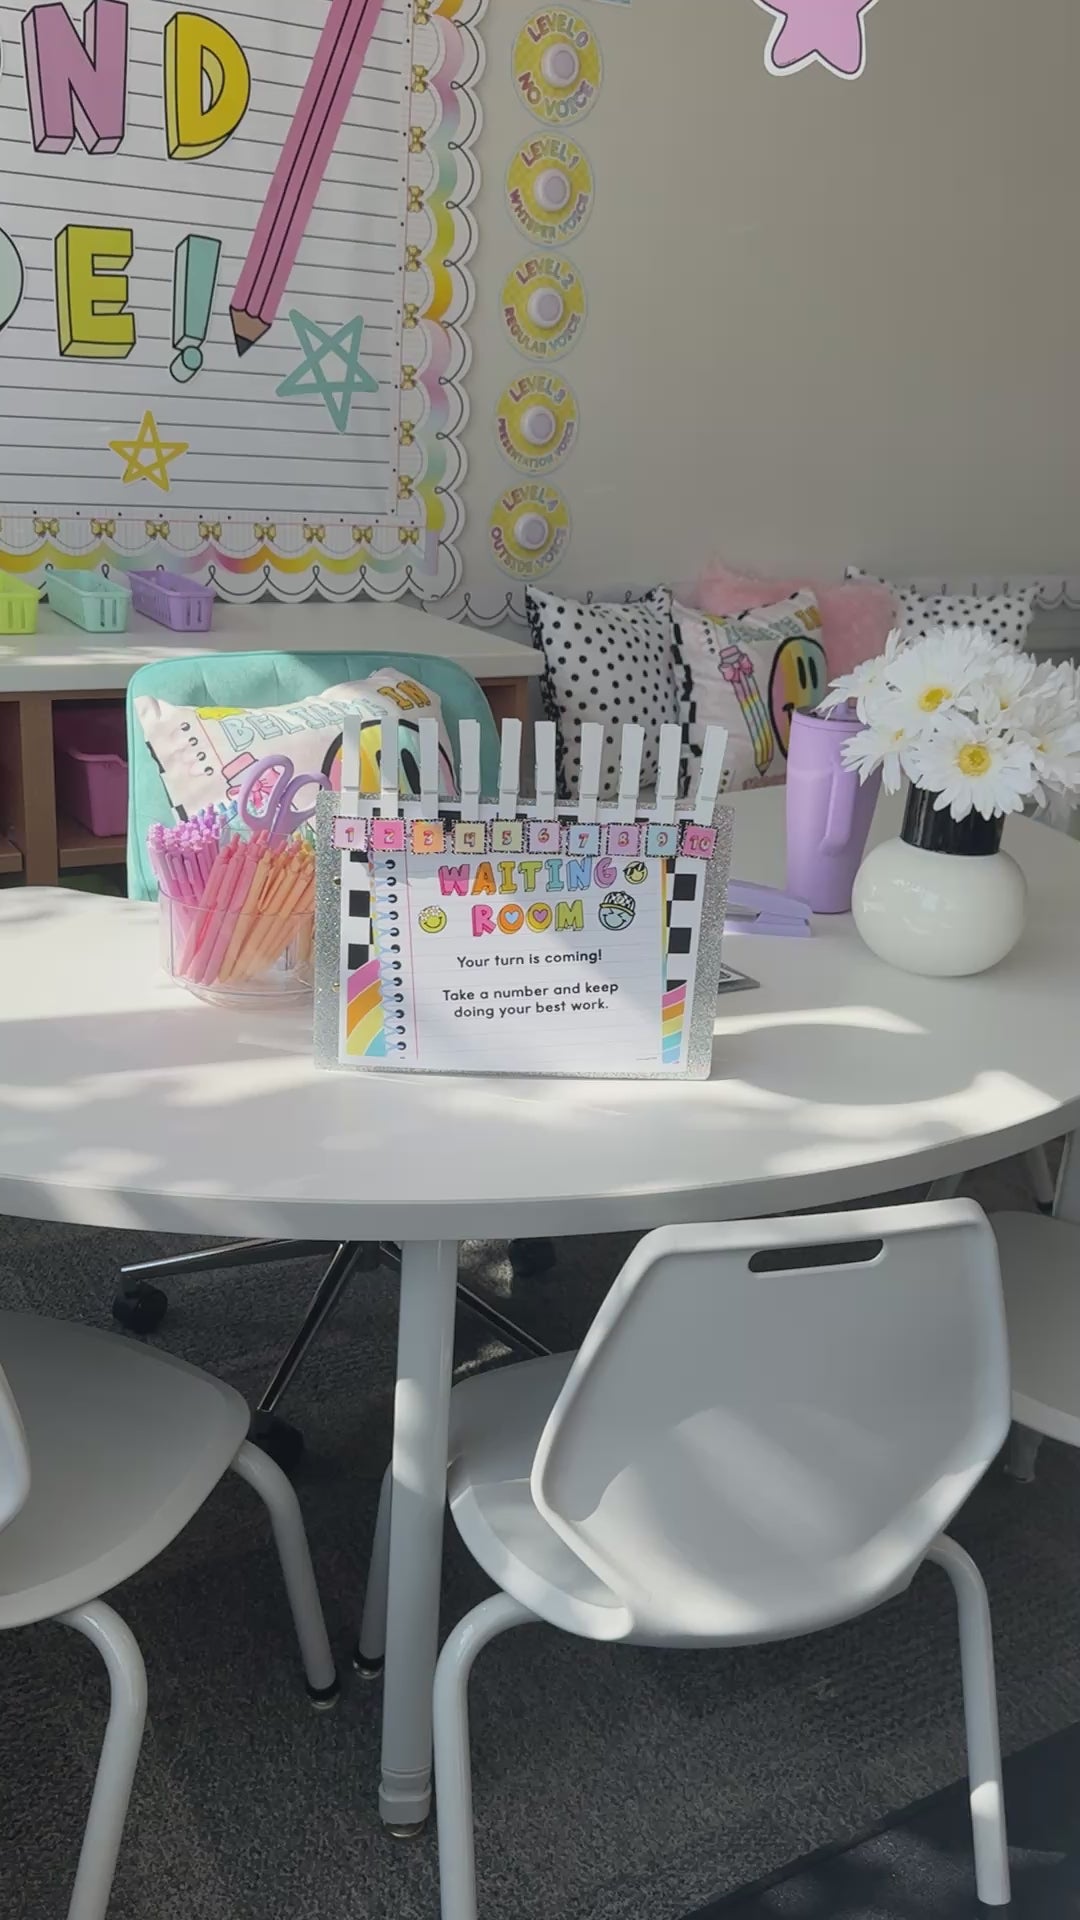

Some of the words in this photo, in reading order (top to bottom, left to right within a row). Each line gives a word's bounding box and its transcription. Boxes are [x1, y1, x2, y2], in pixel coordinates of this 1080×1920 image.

[527, 13, 575, 42] LEVEL
[518, 72, 541, 104] NO
[544, 80, 594, 118] VOICE
[521, 139, 566, 167] LEVEL
[568, 155, 580, 169] 1
[510, 188, 556, 239] WHISPER
[559, 193, 590, 234] VOICE
[515, 258, 561, 284] LEVEL
[560, 273, 574, 290] 2
[0, 224, 222, 383] E!
[504, 307, 548, 355] REGULAR
[549, 313, 581, 352] VOICE
[509, 376, 552, 402] LEVEL
[554, 388, 566, 405] 3
[498, 418, 554, 468] PRESENTATION
[554, 421, 575, 457] VOICE
[502, 486, 545, 512] LEVEL
[491, 526, 533, 573] OUTSIDE
[535, 528, 567, 568] VOICE
[345, 827, 354, 843] 1
[384, 829, 394, 844] 2
[423, 830, 434, 846] 3
[463, 832, 476, 847] 4
[502, 830, 512, 846] 5
[537, 827, 550, 843] 6
[578, 832, 589, 848] 7
[618, 831, 629, 847] 8
[657, 832, 668, 847] 9
[689, 836, 711, 852] 10
[438, 856, 617, 897] WAITING
[472, 900, 584, 937] ROOM
[457, 956, 490, 968] Your
[495, 955, 524, 966] turn
[529, 953, 540, 964] is
[545, 949, 602, 965] coming!
[442, 989, 475, 1001] Take
[480, 991, 489, 1000] a
[493, 985, 549, 999] number
[553, 982, 580, 995] and
[585, 981, 619, 996] keep
[454, 1005, 494, 1019] doing
[499, 1005, 531, 1018] your
[536, 1001, 566, 1013] best
[571, 998, 609, 1012] work.
